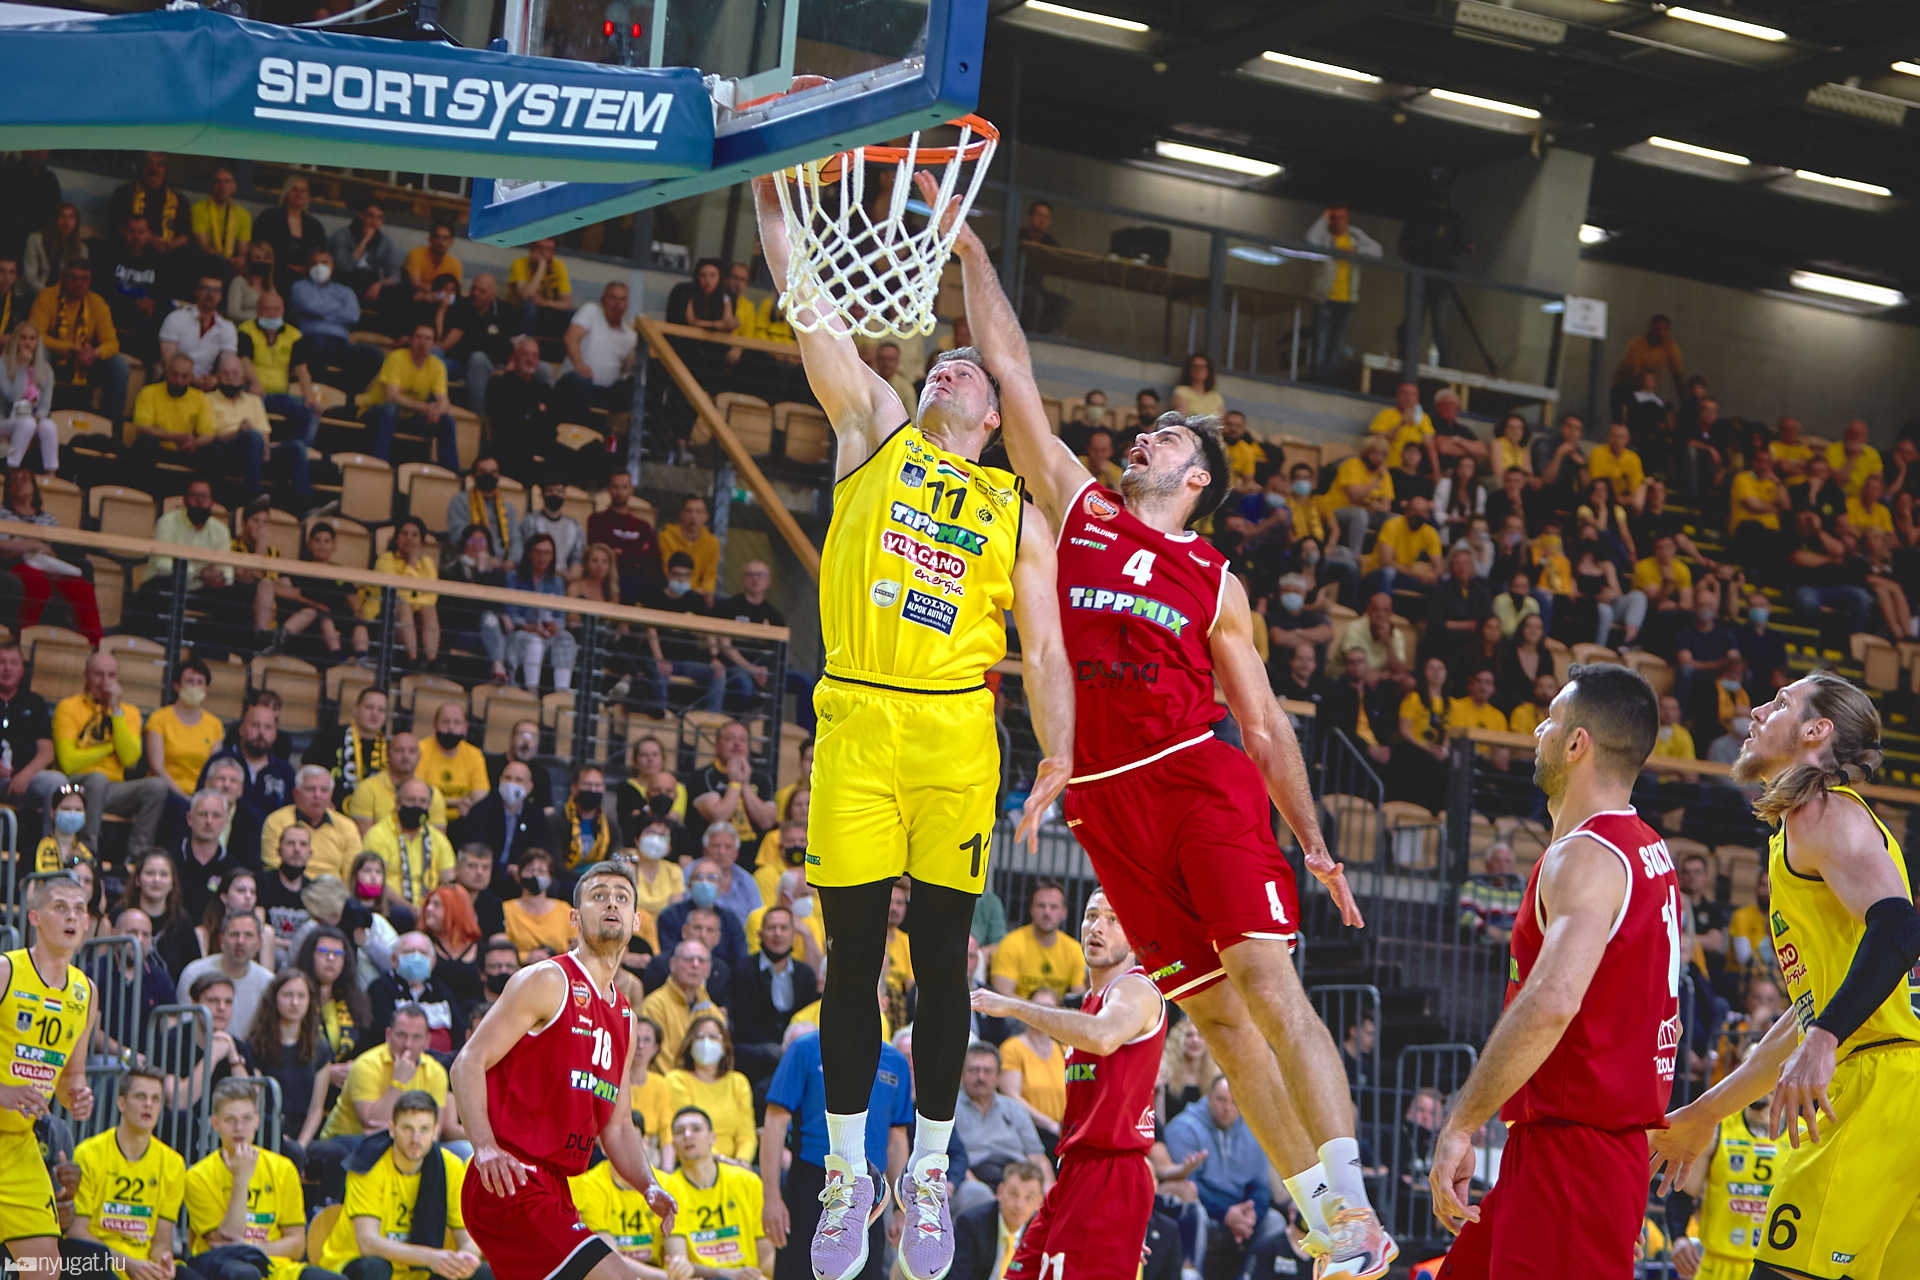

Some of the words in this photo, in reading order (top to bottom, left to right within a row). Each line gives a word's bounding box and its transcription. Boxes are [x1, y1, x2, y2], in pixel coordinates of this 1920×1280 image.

[927, 481, 967, 519] 11
[1084, 522, 1119, 541] SPALDING
[886, 533, 962, 577] VULCANO
[1121, 548, 1157, 586] 4
[914, 568, 964, 594] energia
[906, 601, 927, 616] ALPOK
[912, 592, 954, 615] VOLVO
[959, 832, 990, 878] 1
[1264, 880, 1289, 924] 4
[36, 1015, 62, 1046] 10
[592, 1027, 612, 1071] 18
[1753, 1156, 1772, 1182] 5
[114, 1176, 145, 1202] 22
[620, 1209, 642, 1232] 14
[697, 1205, 725, 1230] 21
[1768, 1203, 1801, 1250] 6
